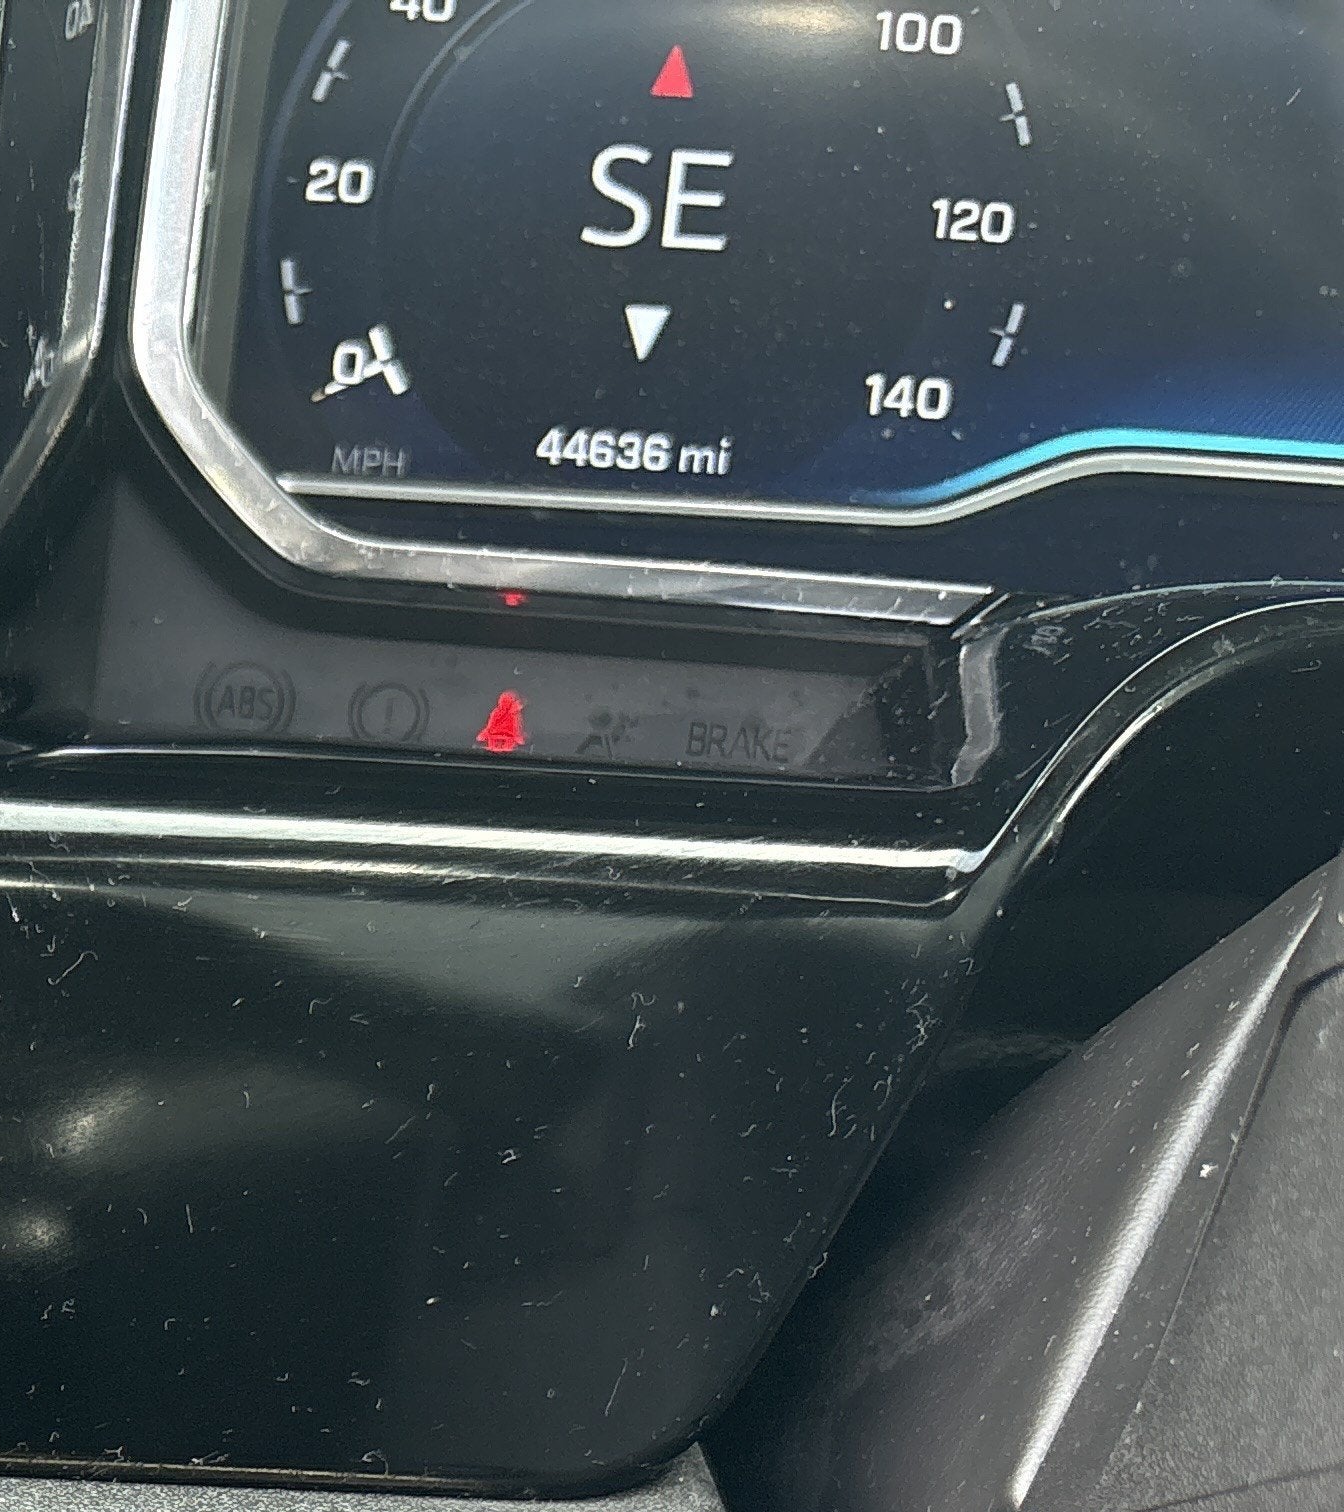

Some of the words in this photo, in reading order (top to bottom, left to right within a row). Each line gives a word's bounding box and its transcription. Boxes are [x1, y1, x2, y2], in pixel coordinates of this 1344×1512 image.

[877, 11, 963, 55] 100
[305, 156, 376, 204] 20
[580, 143, 735, 251] SE
[932, 198, 1014, 243] 120
[866, 373, 952, 420] 140
[331, 445, 406, 476] MPH
[536, 426, 672, 472] 44636
[678, 435, 734, 475] mi
[217, 684, 274, 720] ABS
[685, 719, 792, 763] BRAKE
